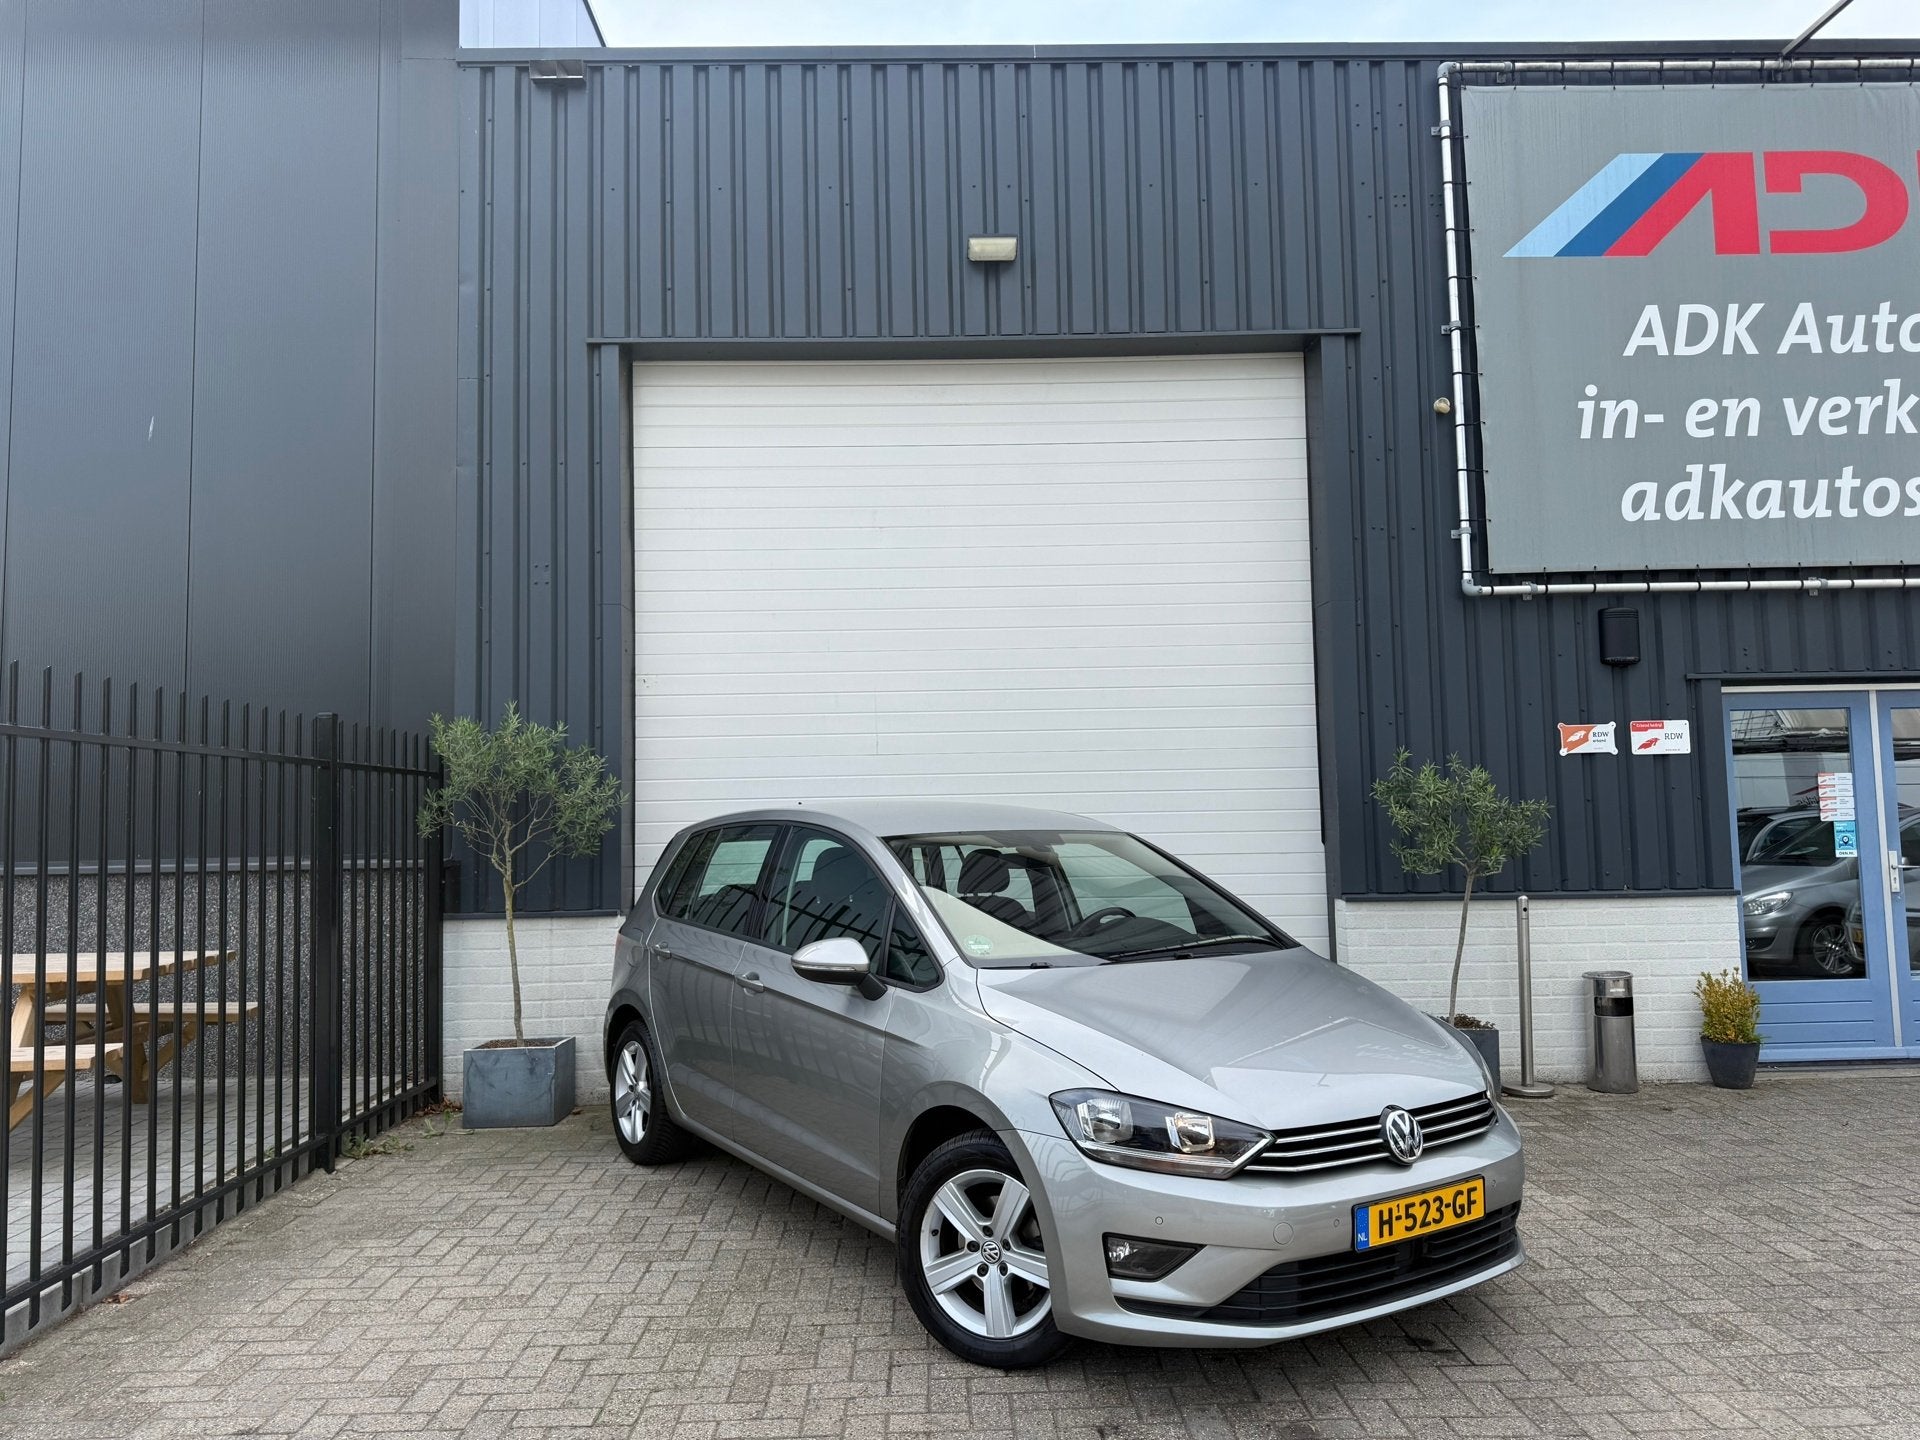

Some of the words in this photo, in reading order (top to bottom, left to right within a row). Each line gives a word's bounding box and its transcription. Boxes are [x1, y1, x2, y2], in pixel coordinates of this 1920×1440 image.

[1603, 149, 1920, 257] AD
[1622, 303, 1765, 356] ADK
[1577, 384, 1664, 439] in-
[1685, 396, 1761, 438] en
[1783, 378, 1920, 436] verk
[1664, 732, 1683, 740] RDW
[1358, 1232, 1367, 1242] NL
